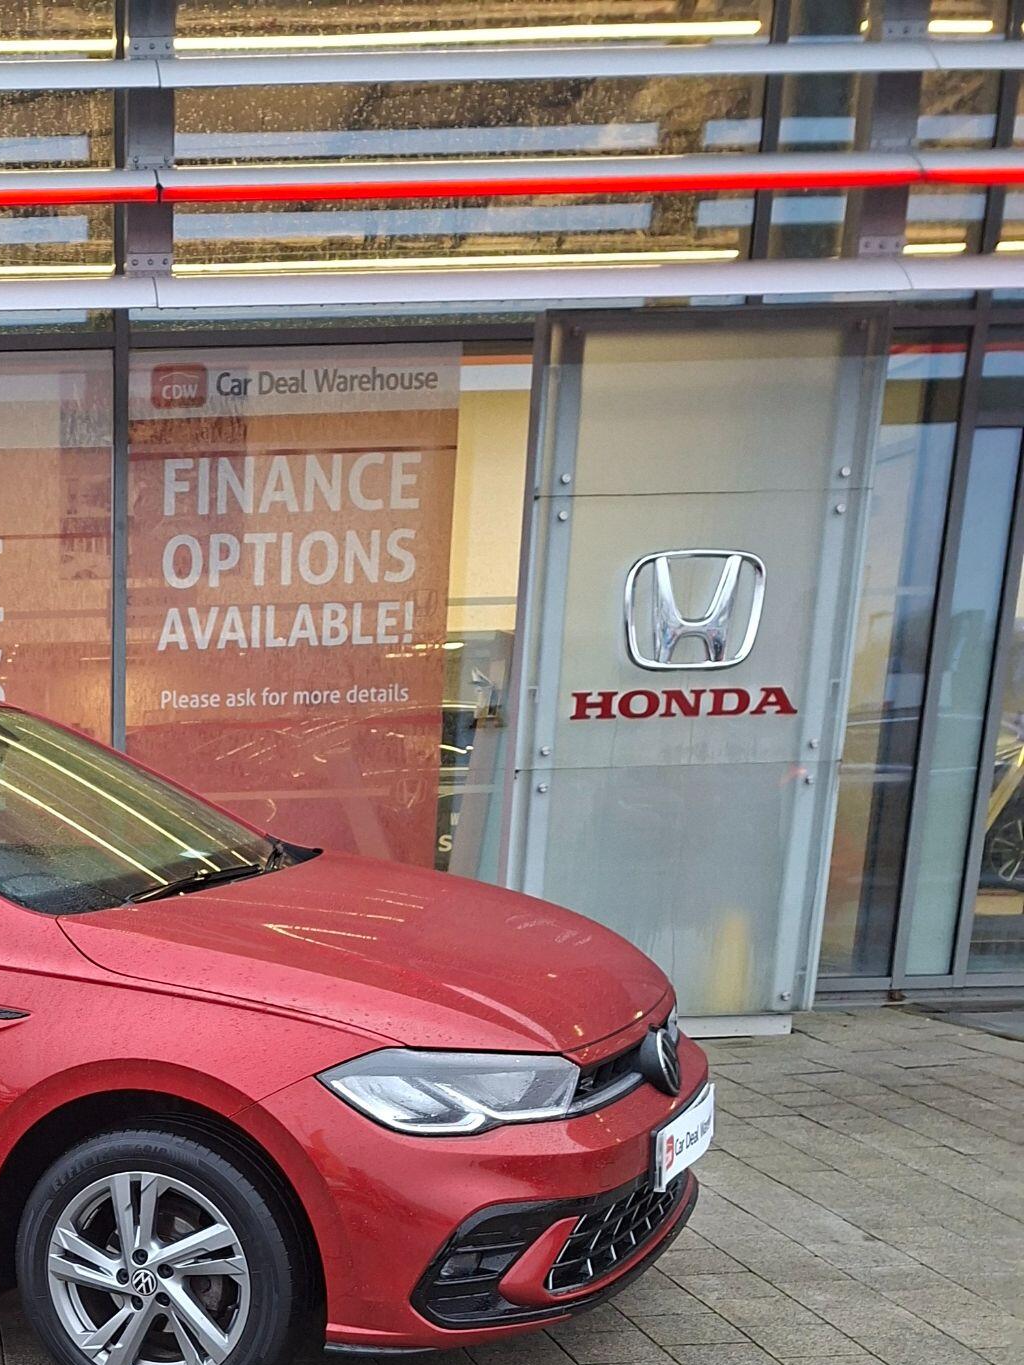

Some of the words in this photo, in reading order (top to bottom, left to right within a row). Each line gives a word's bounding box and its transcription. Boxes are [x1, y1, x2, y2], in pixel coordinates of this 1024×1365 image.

[161, 384, 198, 400] CDW
[216, 372, 252, 396] Car
[257, 370, 307, 395] Deal
[314, 366, 438, 393] Warehouse
[162, 452, 421, 517] FINANCE
[161, 529, 417, 589] OPTIONS
[157, 601, 415, 651] AVAILABLE!
[160, 690, 221, 709] Please
[226, 688, 256, 707] ask
[262, 687, 288, 706] for
[293, 690, 340, 704] more
[346, 684, 409, 703] details
[570, 686, 797, 720] HONDA
